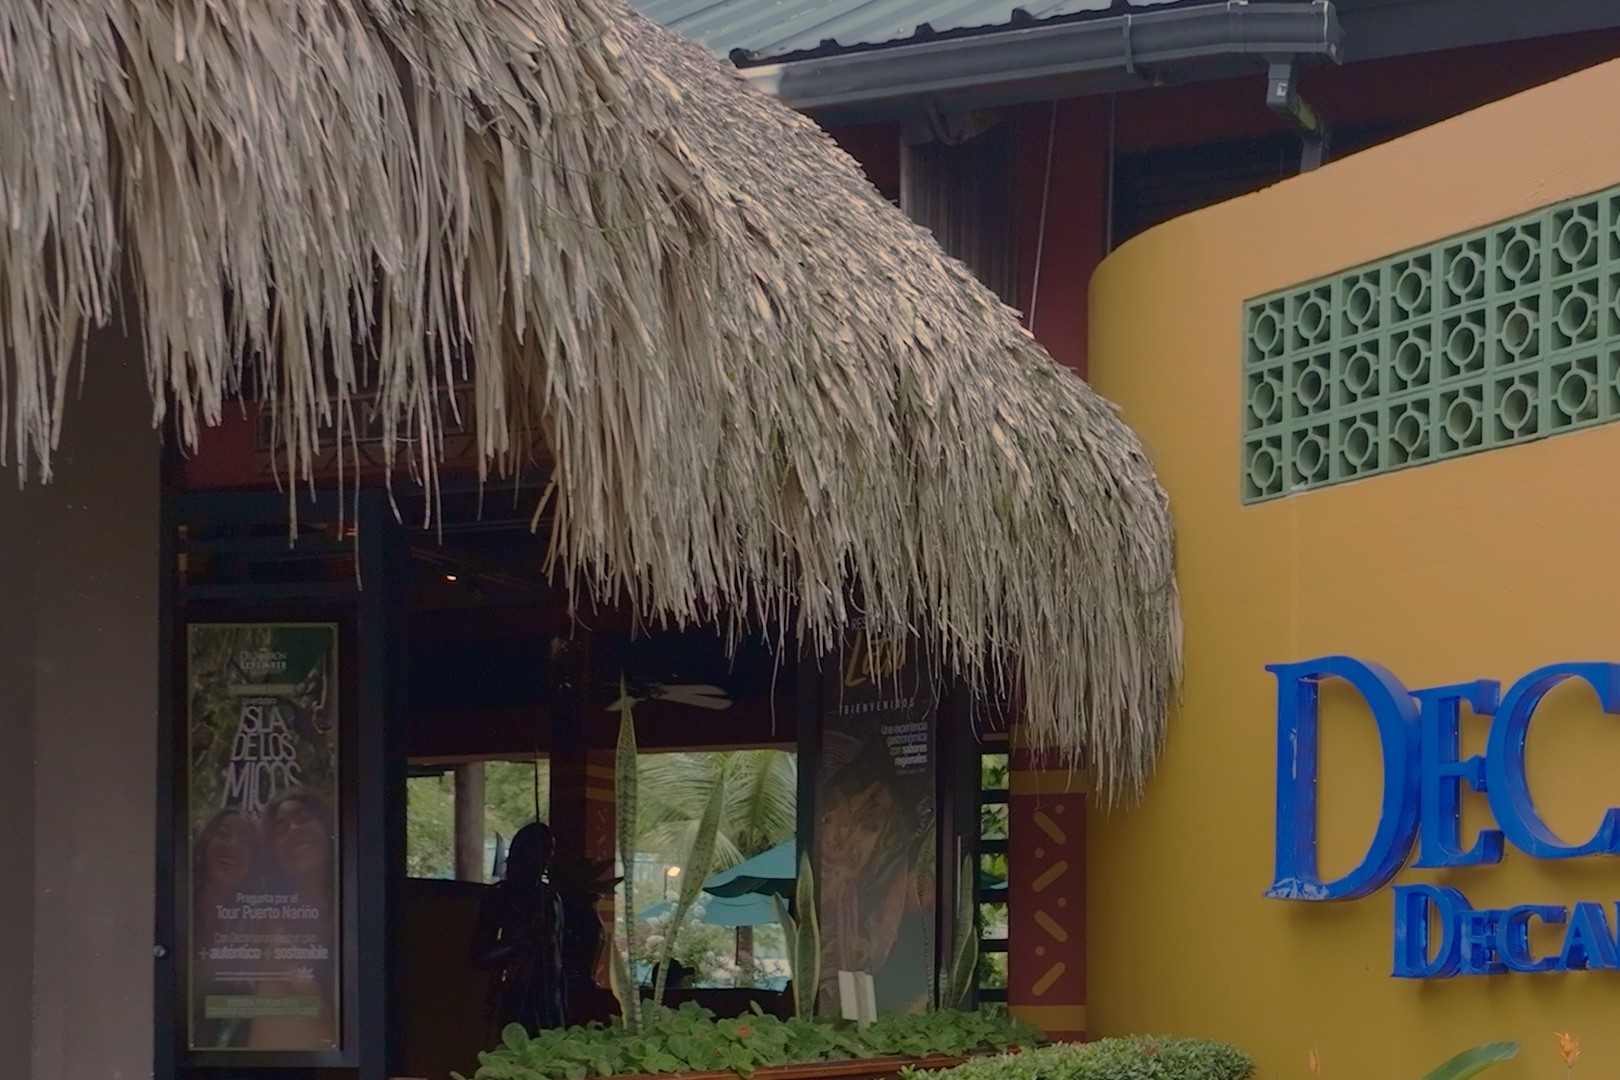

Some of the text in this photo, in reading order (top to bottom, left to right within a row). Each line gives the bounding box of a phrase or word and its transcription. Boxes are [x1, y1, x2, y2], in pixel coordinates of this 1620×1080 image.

[844, 697, 914, 715] BIENVENIDOS
[238, 706, 290, 733] ISLA
[231, 732, 297, 761] DE LOS
[236, 892, 299, 906] Pregunta por el
[216, 904, 320, 919] Tour Puerto Nariño
